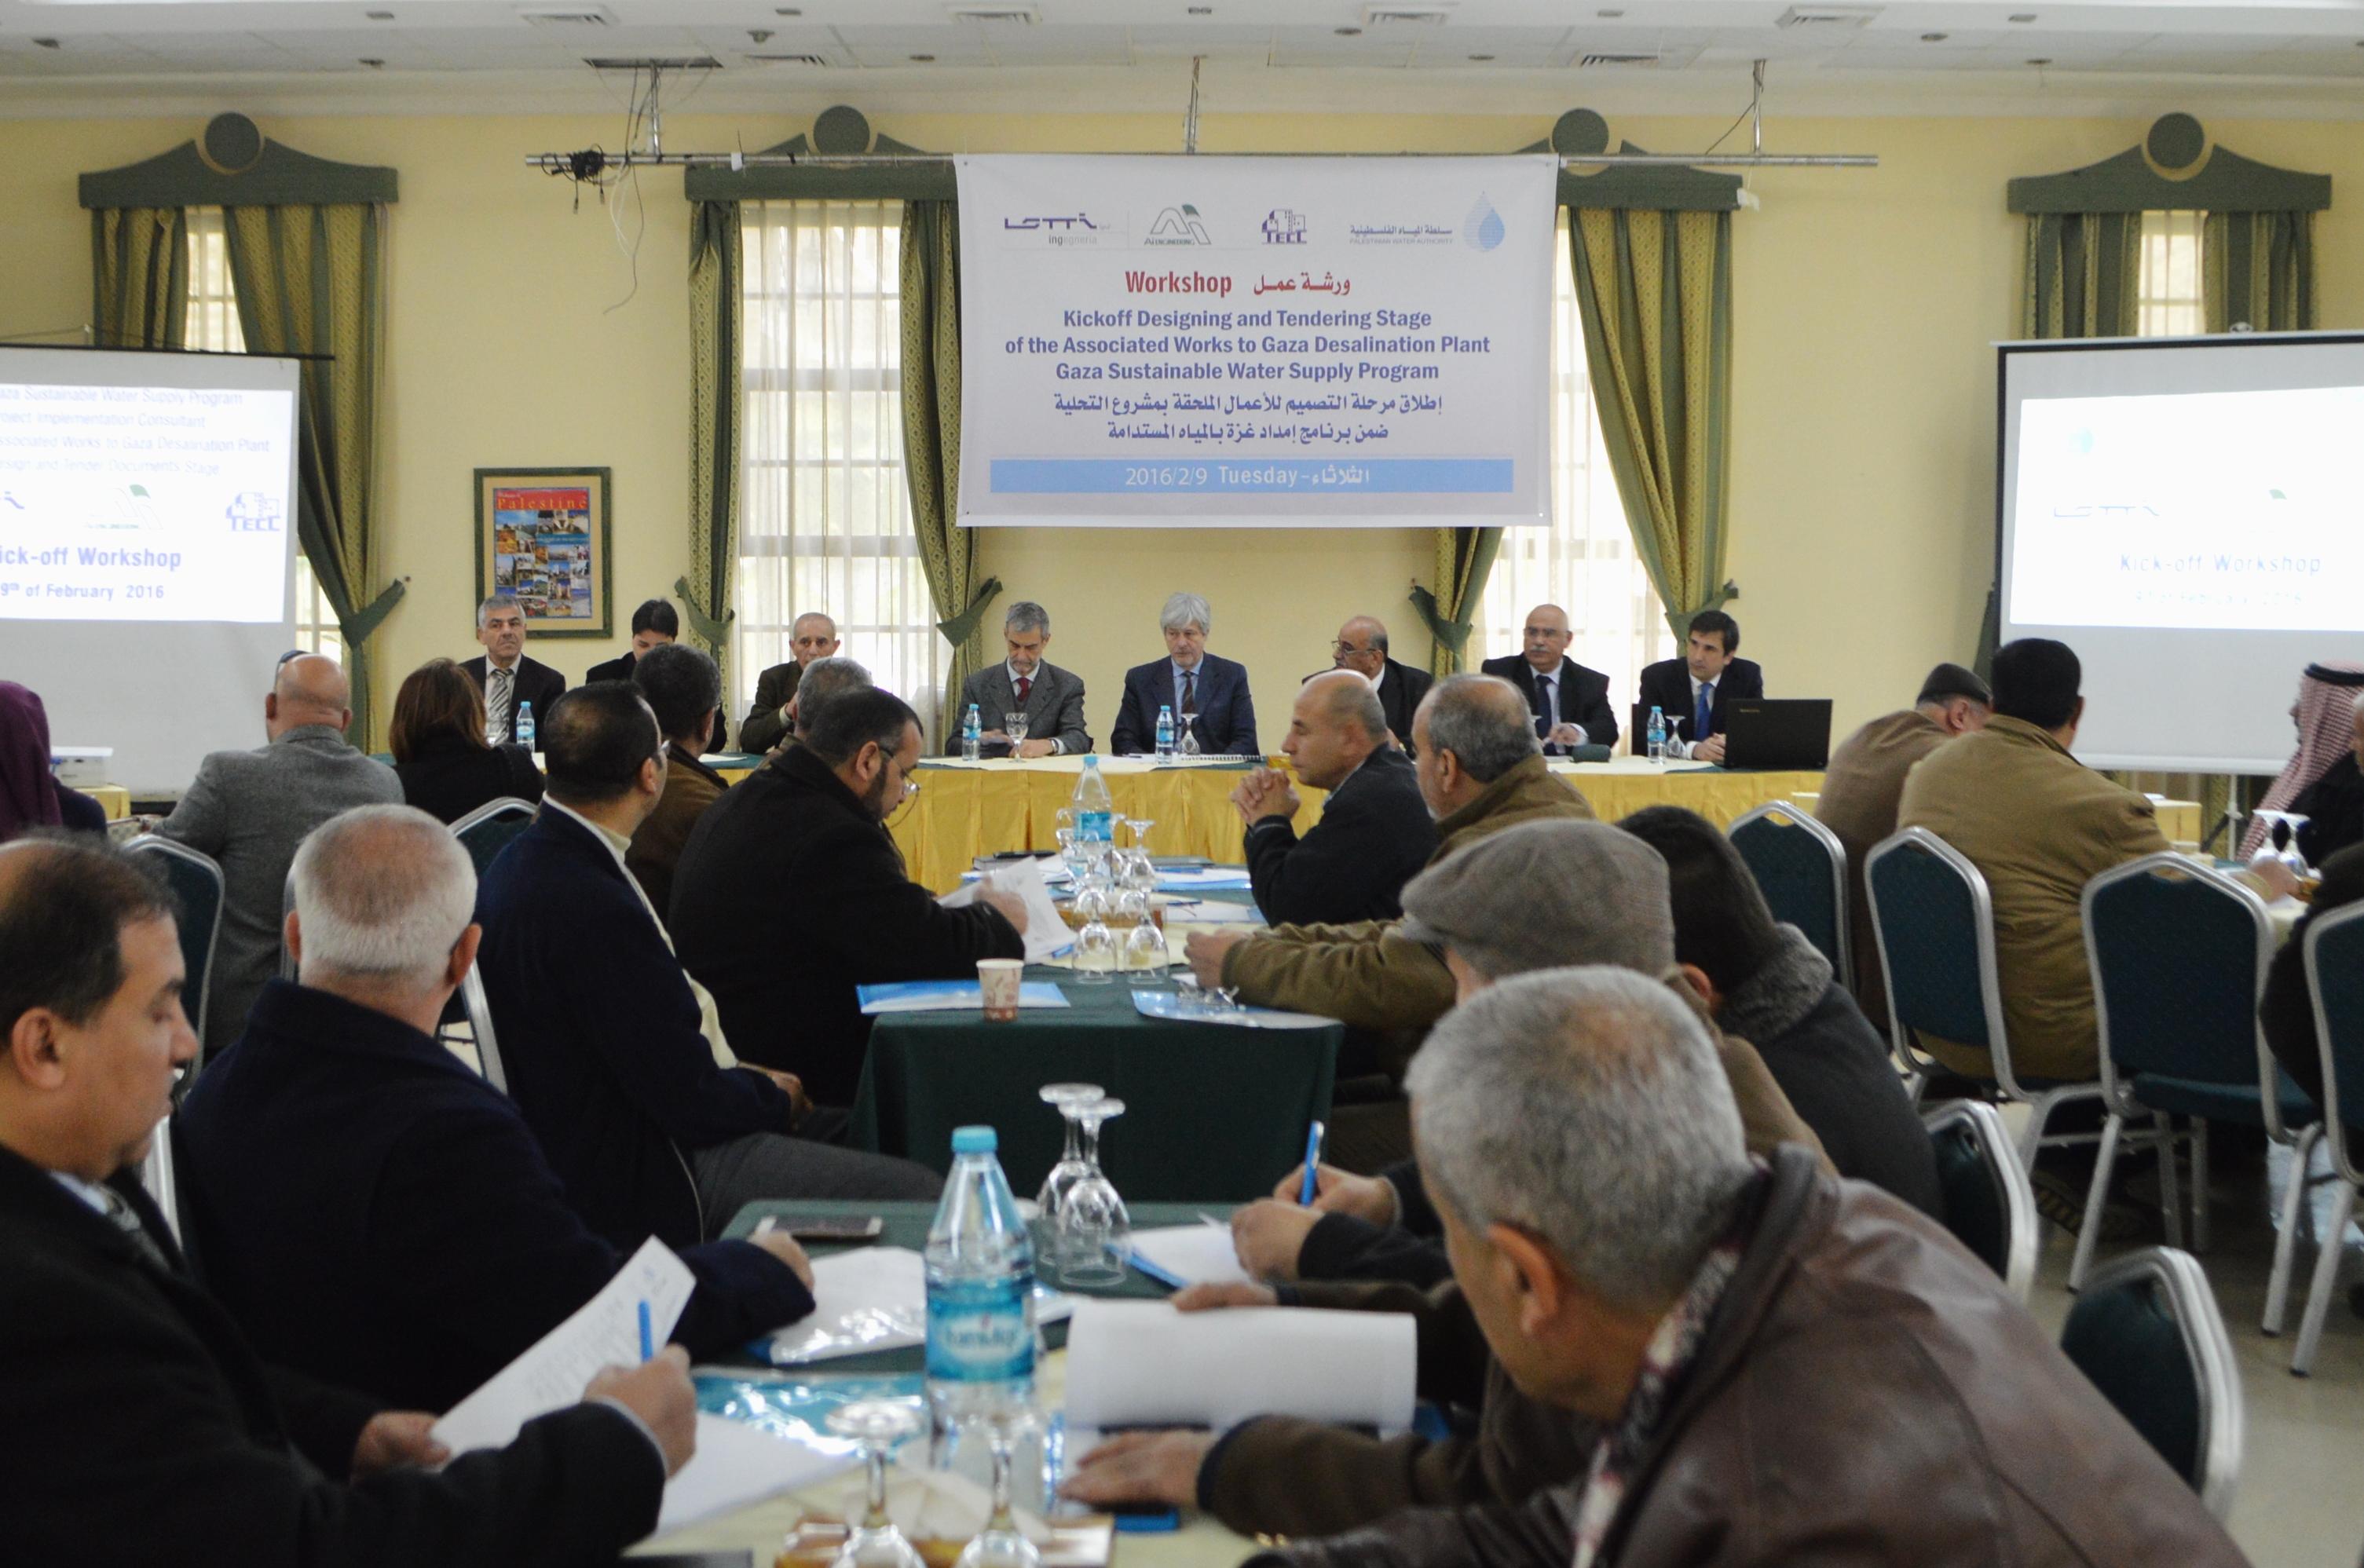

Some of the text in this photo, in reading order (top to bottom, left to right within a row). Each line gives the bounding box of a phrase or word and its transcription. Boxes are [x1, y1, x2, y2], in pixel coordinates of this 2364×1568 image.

[1125, 271, 1231, 298] Workshop
[1253, 272, 1351, 296] ورشة عمل
[1064, 309, 1431, 331] Kickoff Designing and Tendering Stage
[1005, 336, 1490, 353] of the Associated Works to Gaza Desalination Plant
[1056, 362, 1438, 382] Gaza Sustainable Water Supply Program
[101, 388, 138, 402] Water
[143, 388, 185, 405] Supply
[189, 391, 243, 407] Program
[1054, 392, 1442, 416] إطلاق مرحلة التصميم للأعمال الملحقة بمشروع التحلية
[1108, 422, 1389, 444] ضمن برنامج إمداد غزة بالمياه المستدامة
[238, 437, 271, 453] Plant
[1125, 467, 1207, 485] 2016/2/9
[498, 498, 587, 510] Palestine
[0, 546, 182, 572] ick-off Workshop
[2214, 553, 2322, 576] Workshop
[25, 583, 40, 598] of
[46, 583, 114, 602] February
[126, 585, 165, 598] 2016
